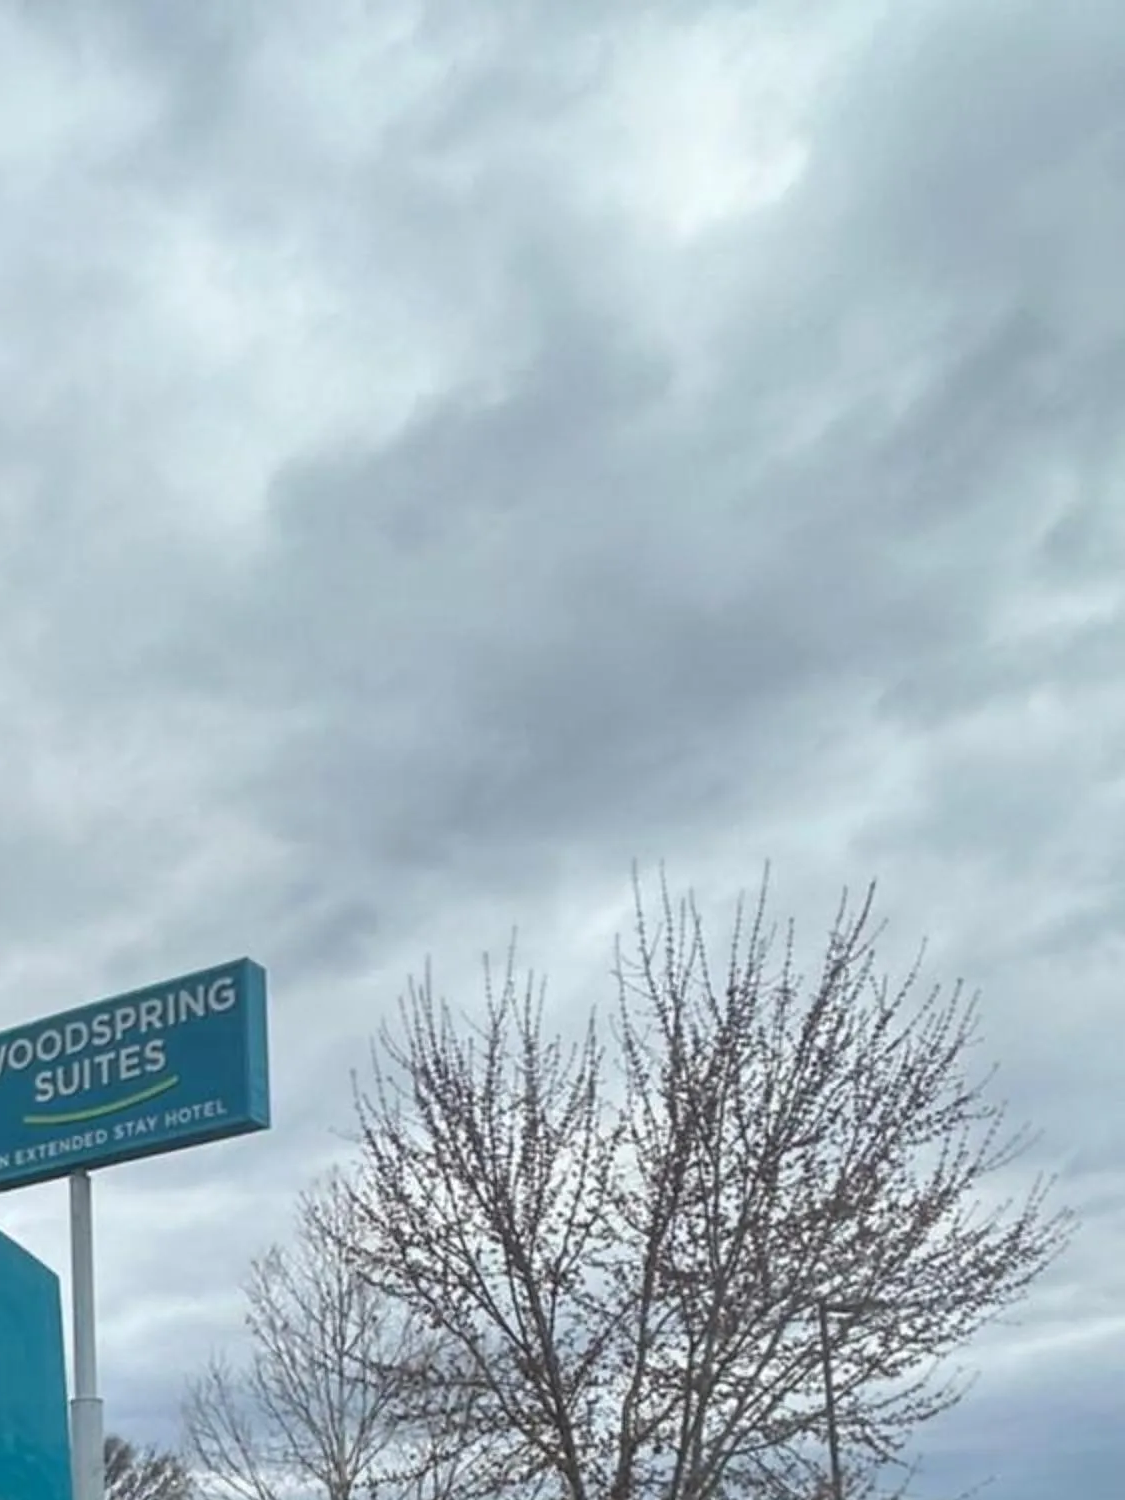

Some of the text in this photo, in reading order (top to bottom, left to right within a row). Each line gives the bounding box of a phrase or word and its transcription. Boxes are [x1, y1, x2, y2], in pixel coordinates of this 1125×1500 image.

[34, 1039, 166, 1102] SUITES
[15, 1129, 108, 1165] EXTENDED
[113, 1115, 159, 1140] STAY
[164, 1098, 228, 1129] HOTEL
